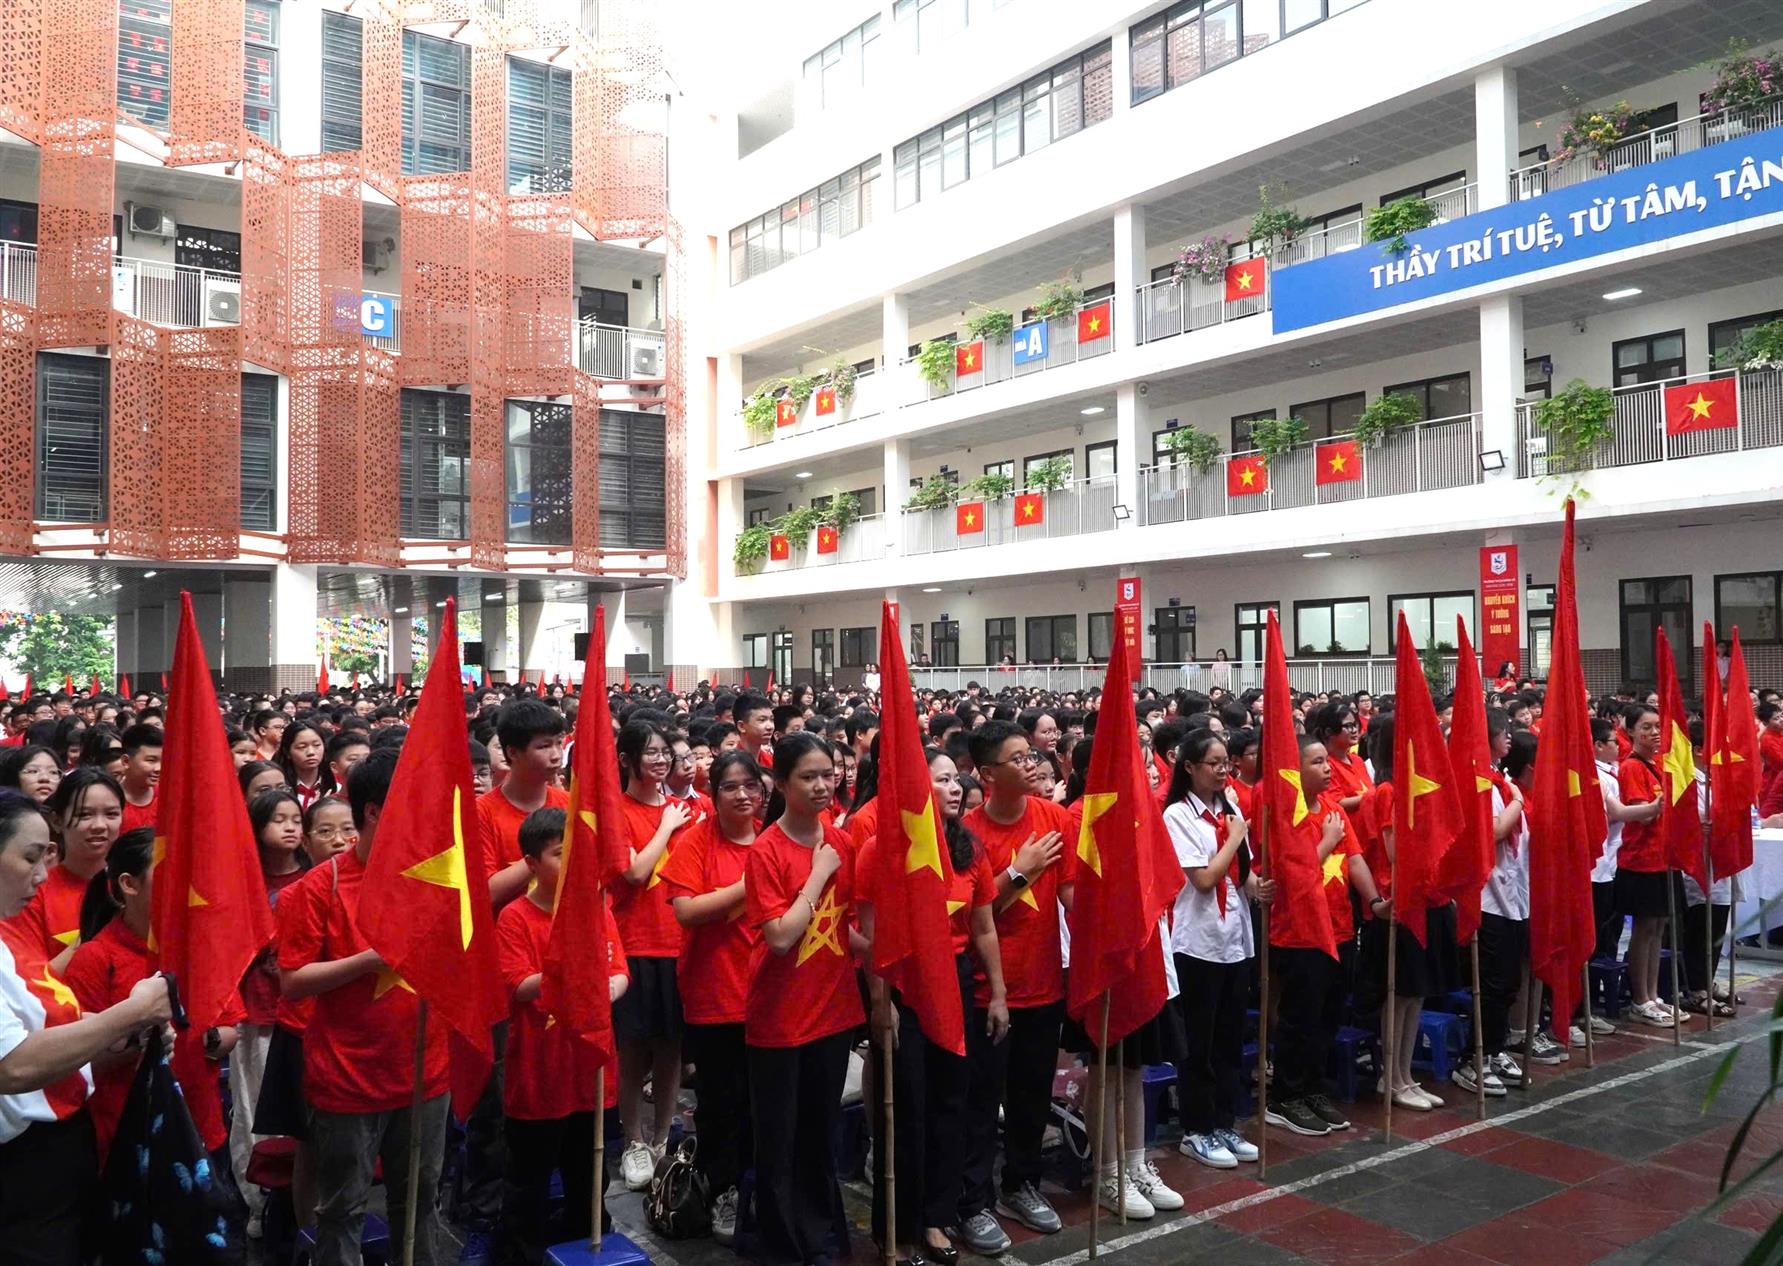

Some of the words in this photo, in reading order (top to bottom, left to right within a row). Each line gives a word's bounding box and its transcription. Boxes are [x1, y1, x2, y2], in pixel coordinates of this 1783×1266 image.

[1370, 244, 1441, 289] THẦY
[1446, 227, 1494, 269] TRÍ
[1497, 212, 1564, 256] TUỆ,
[1568, 196, 1616, 237] TỪ
[1621, 181, 1707, 224] TÂM,
[1713, 155, 1783, 201] TẬN
[361, 300, 385, 331] C
[1027, 328, 1043, 357] A
